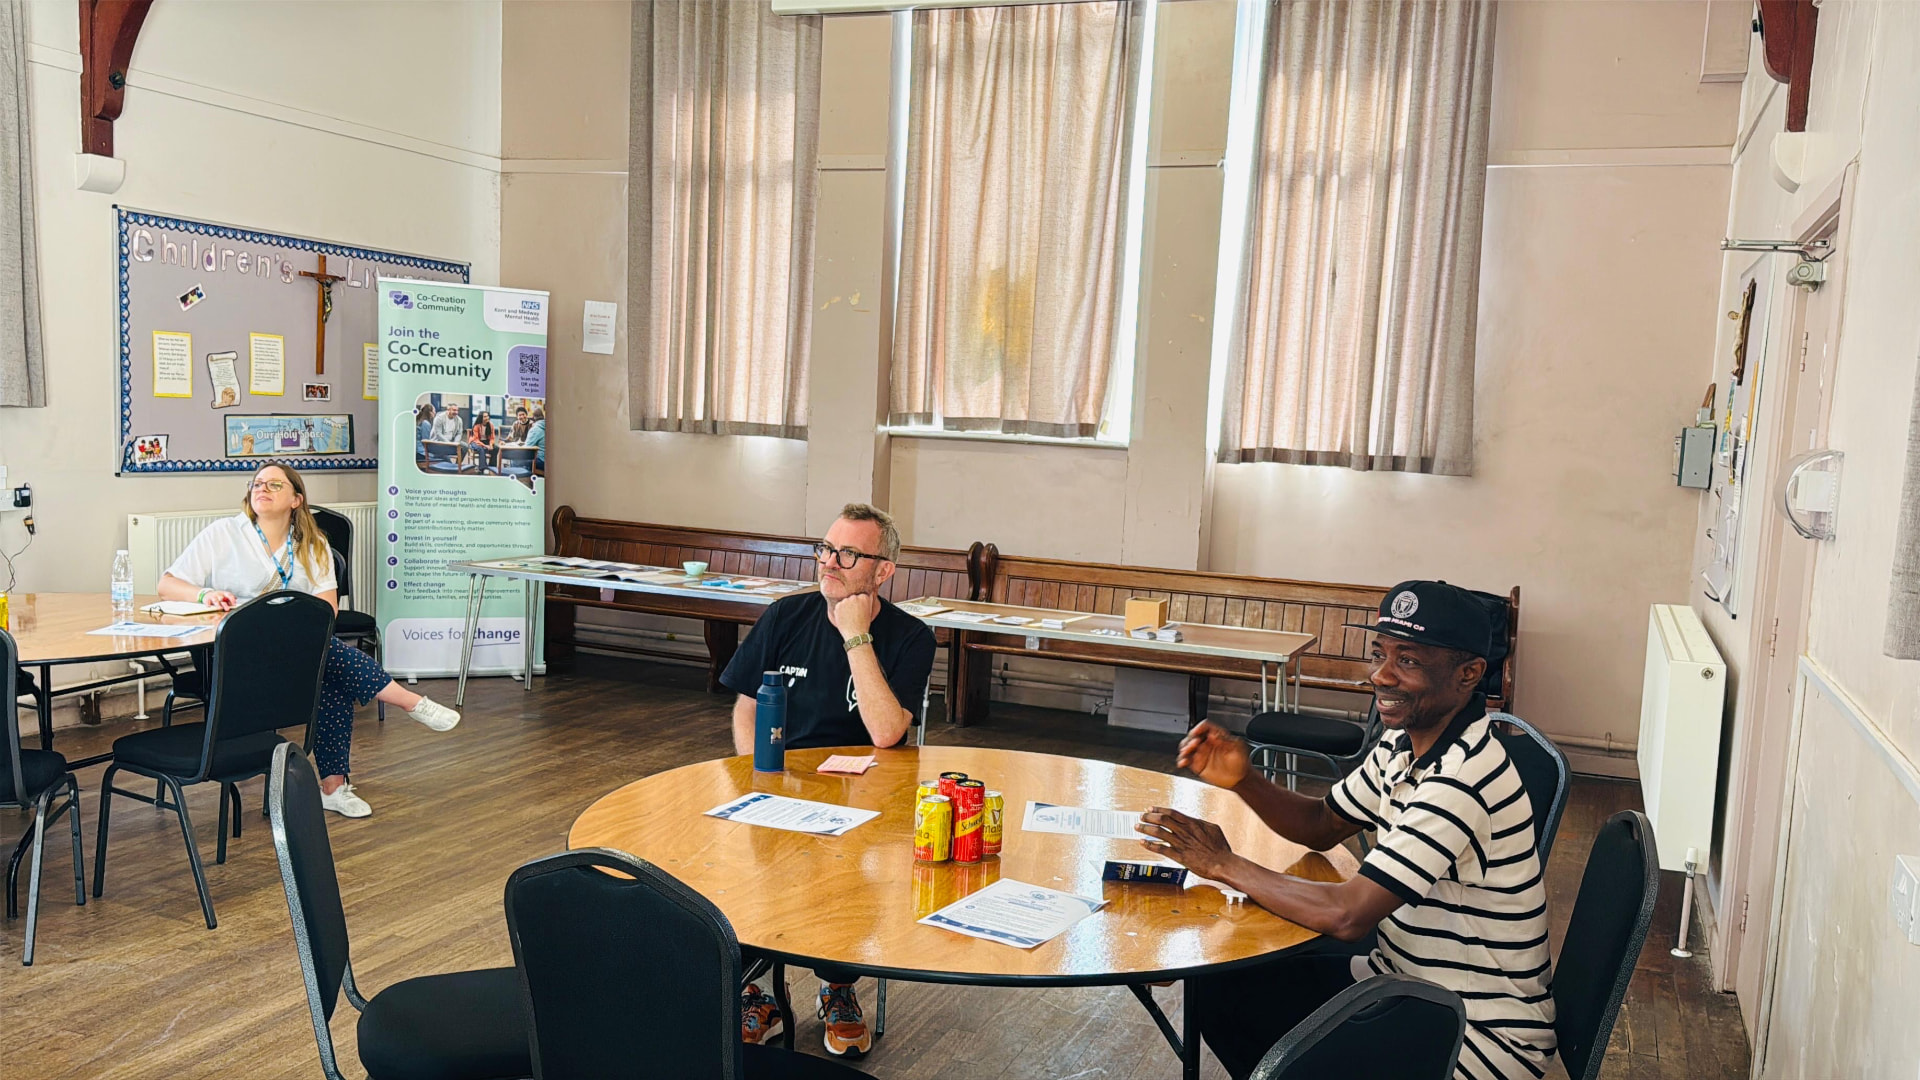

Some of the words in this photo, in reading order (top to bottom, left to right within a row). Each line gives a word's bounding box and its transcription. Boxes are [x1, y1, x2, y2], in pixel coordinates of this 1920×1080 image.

[132, 228, 295, 284] Children's
[417, 293, 466, 304] Co-Creation
[417, 302, 465, 314] Community
[523, 301, 540, 310] NHS
[388, 326, 415, 338] Join
[419, 328, 440, 340] the
[387, 340, 493, 361] Co-Creation
[387, 358, 492, 382] Community
[256, 429, 273, 440] Our
[278, 430, 298, 442] Holy
[300, 430, 325, 440] Space
[439, 488, 467, 496] thoughts
[432, 535, 458, 543] yourself
[403, 628, 444, 641] Voices
